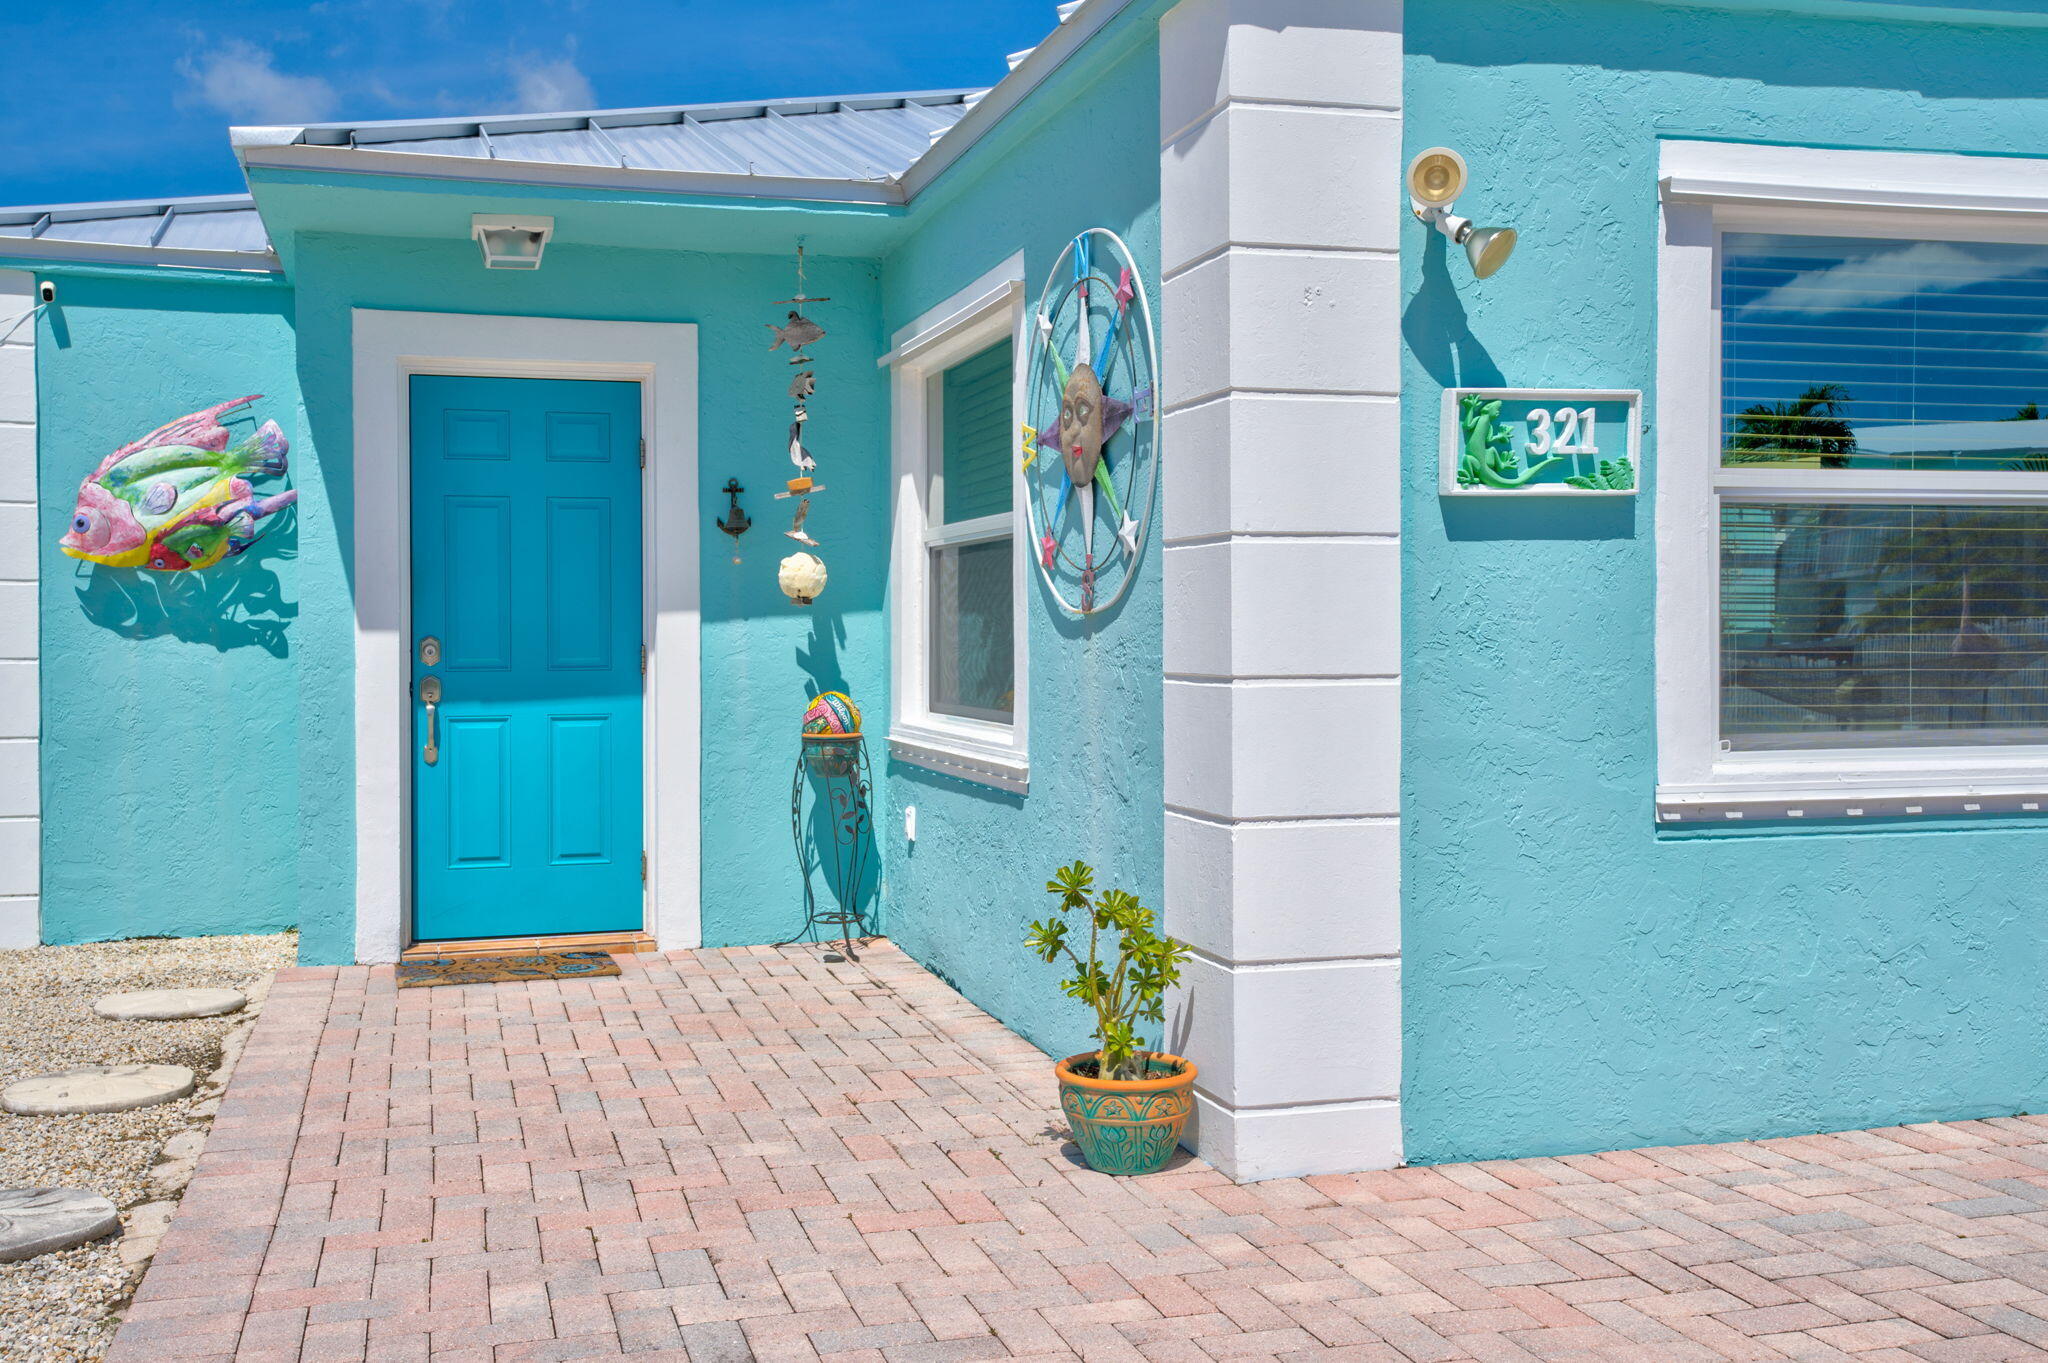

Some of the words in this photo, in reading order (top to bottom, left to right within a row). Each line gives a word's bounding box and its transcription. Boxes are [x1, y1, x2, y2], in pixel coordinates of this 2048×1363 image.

[1072, 231, 1089, 283] N
[1133, 386, 1153, 424] E
[1021, 421, 1037, 472] W
[1524, 407, 1599, 455] 321
[1081, 569, 1094, 613] S
[832, 699, 850, 726] Wilson
